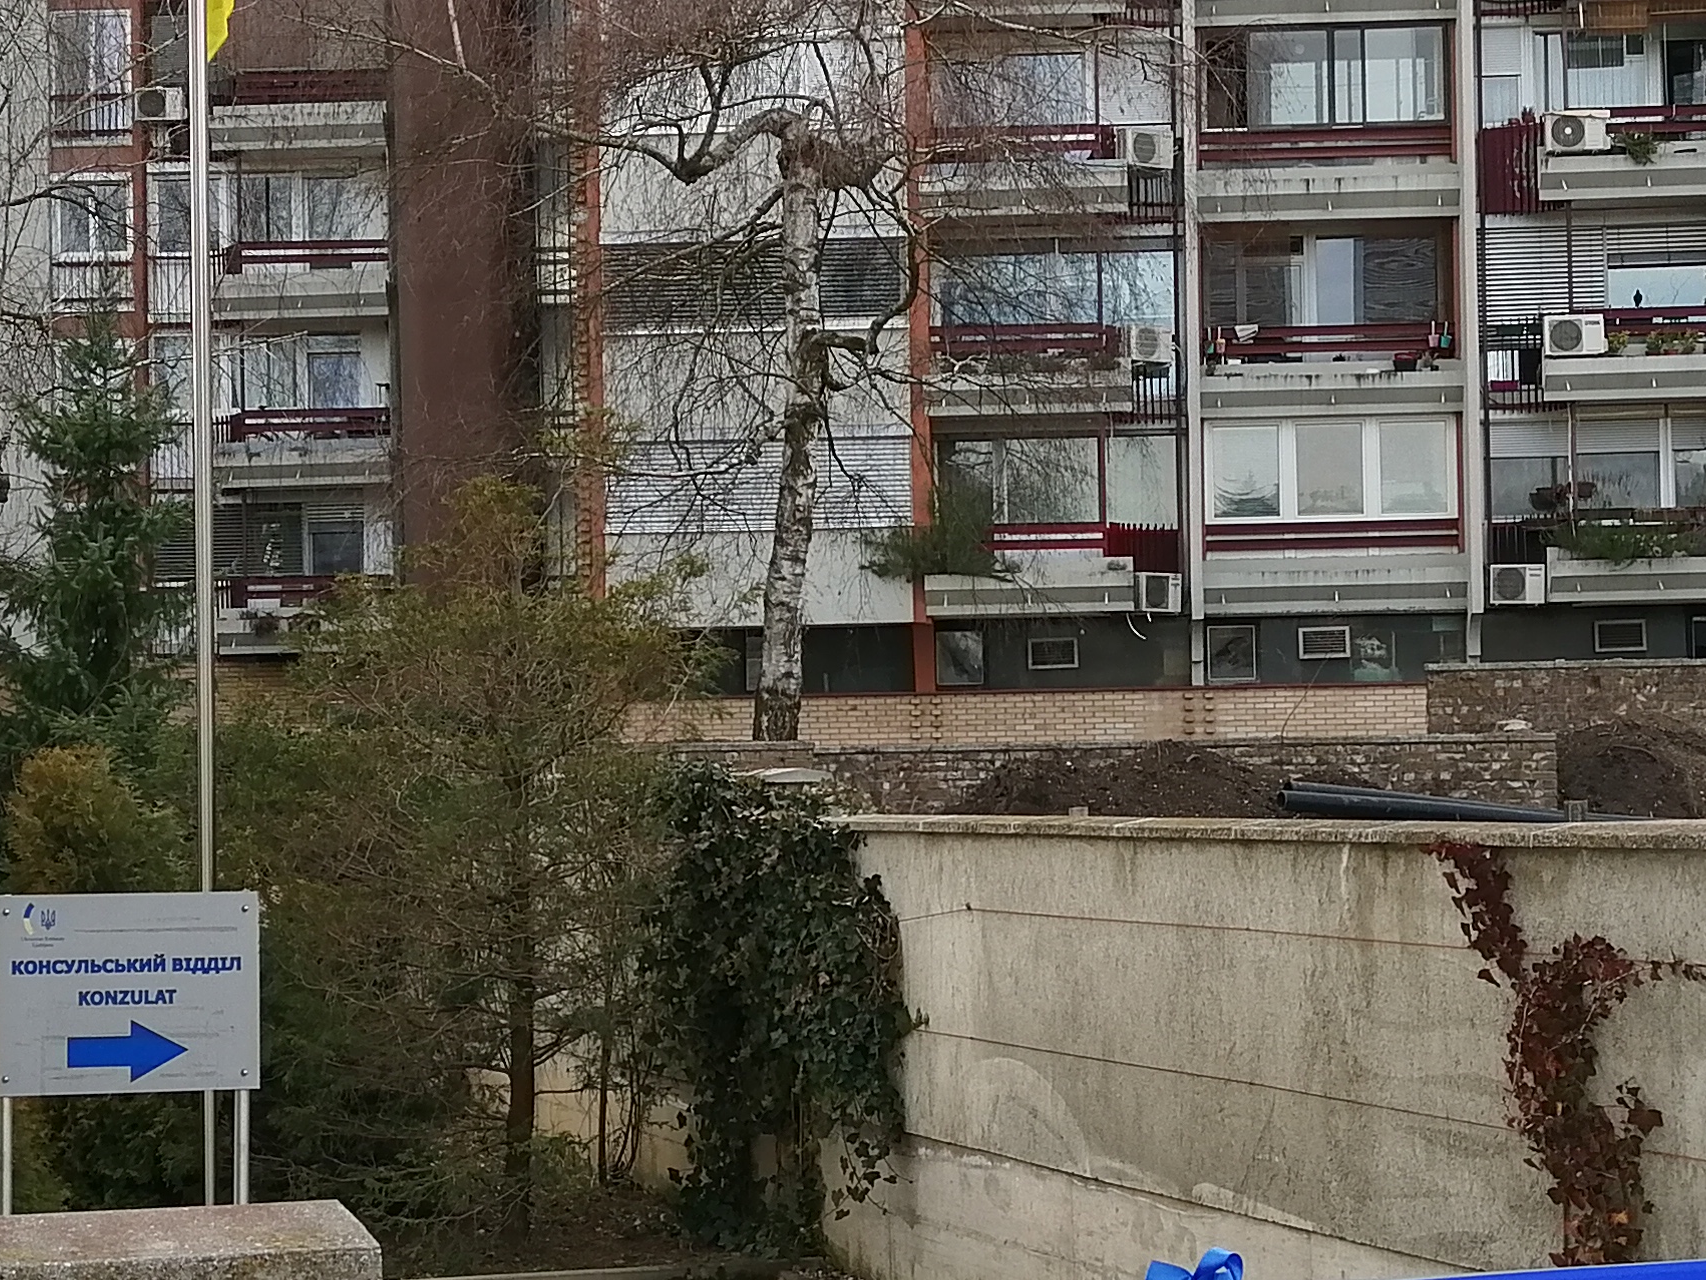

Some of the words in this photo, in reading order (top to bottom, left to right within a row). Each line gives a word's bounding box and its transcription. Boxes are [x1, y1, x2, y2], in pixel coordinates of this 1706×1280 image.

[11, 953, 166, 974] КОНСУЛЬСЬКИЙ
[172, 956, 242, 974] ВІДДІЛ
[78, 989, 177, 1006] KONZULAT
